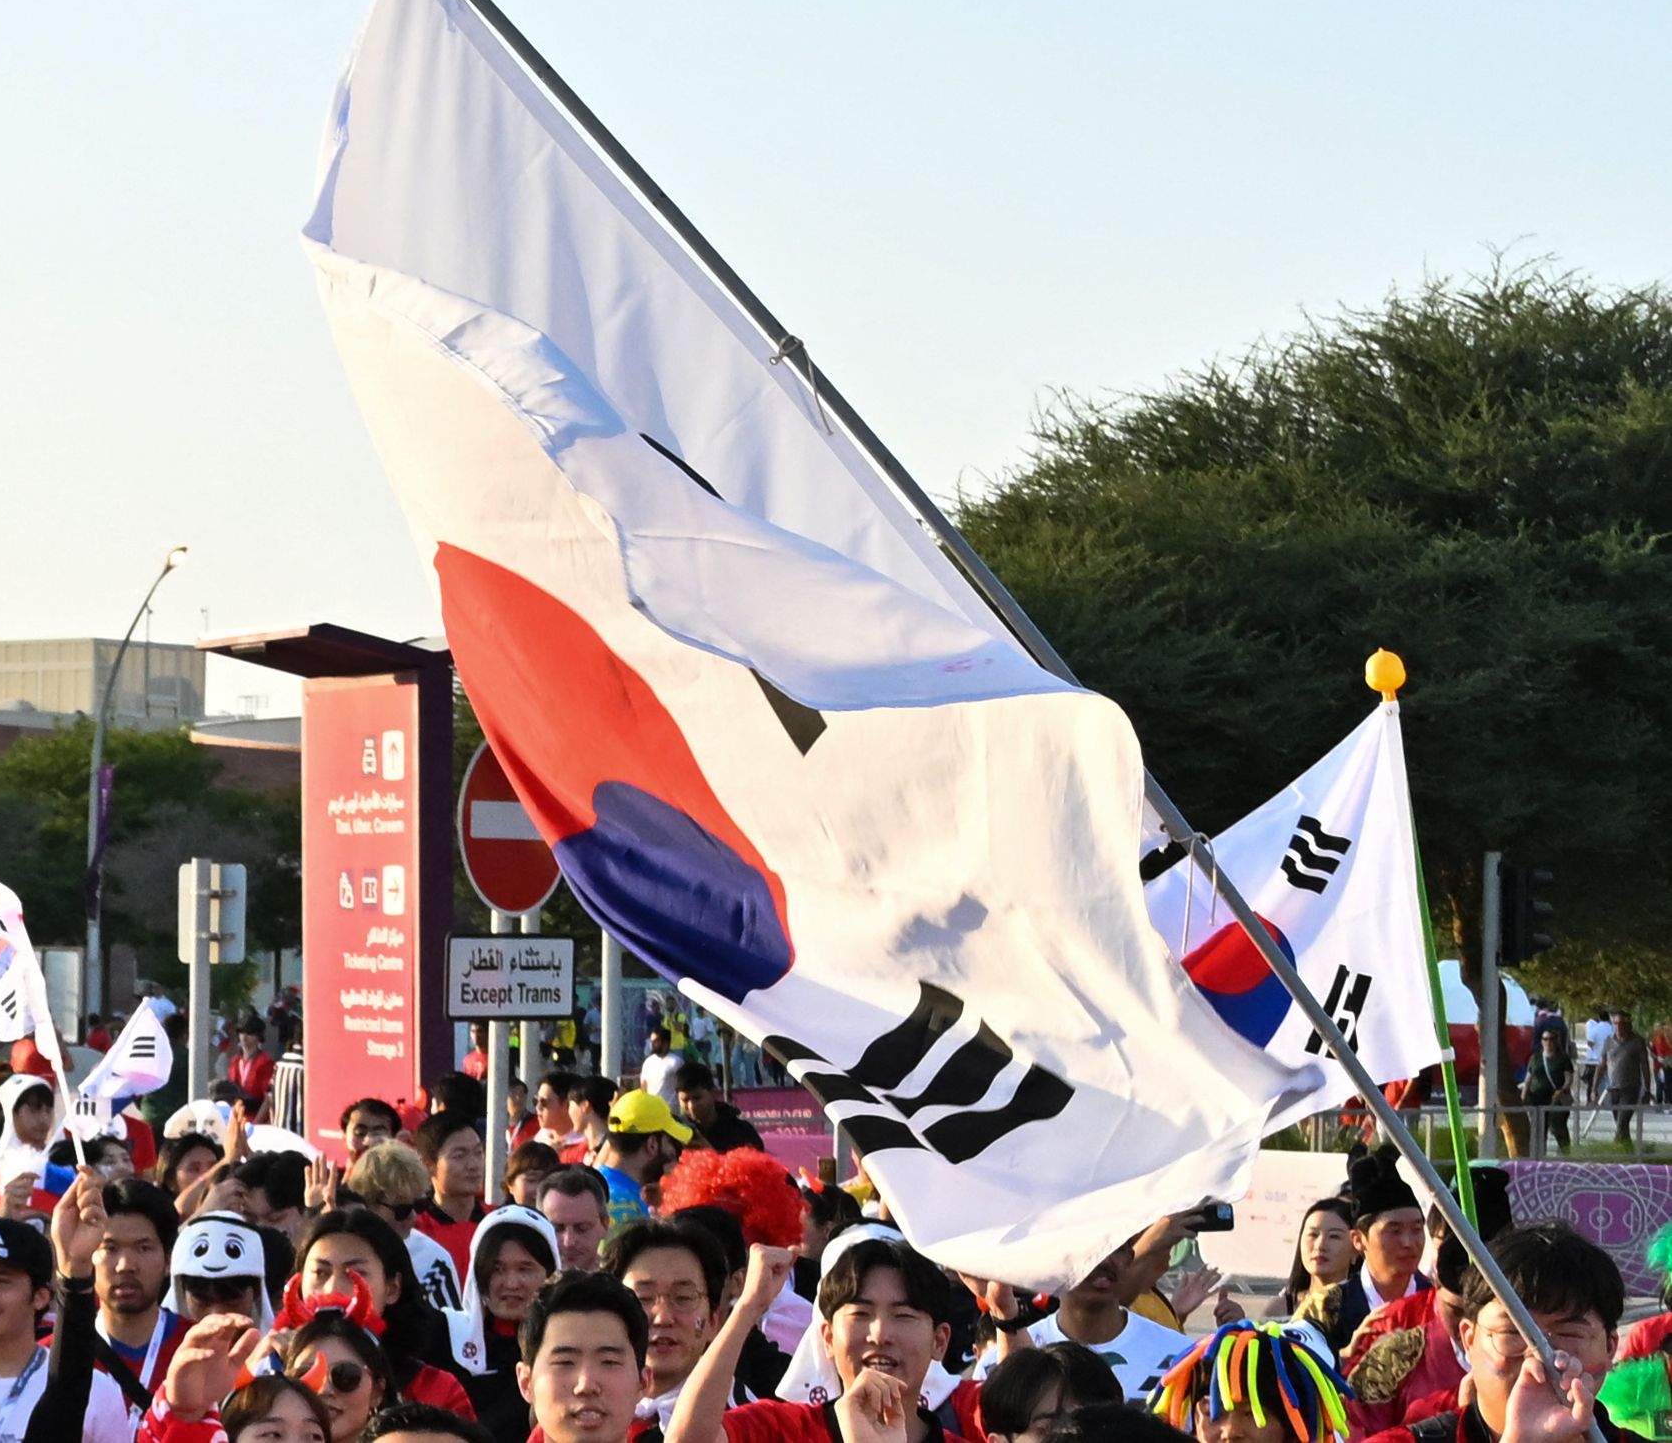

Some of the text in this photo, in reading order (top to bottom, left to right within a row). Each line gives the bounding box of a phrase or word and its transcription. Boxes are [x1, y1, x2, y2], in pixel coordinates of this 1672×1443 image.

[462, 947, 504, 979] القطار
[461, 982, 562, 1009] Except Trams
